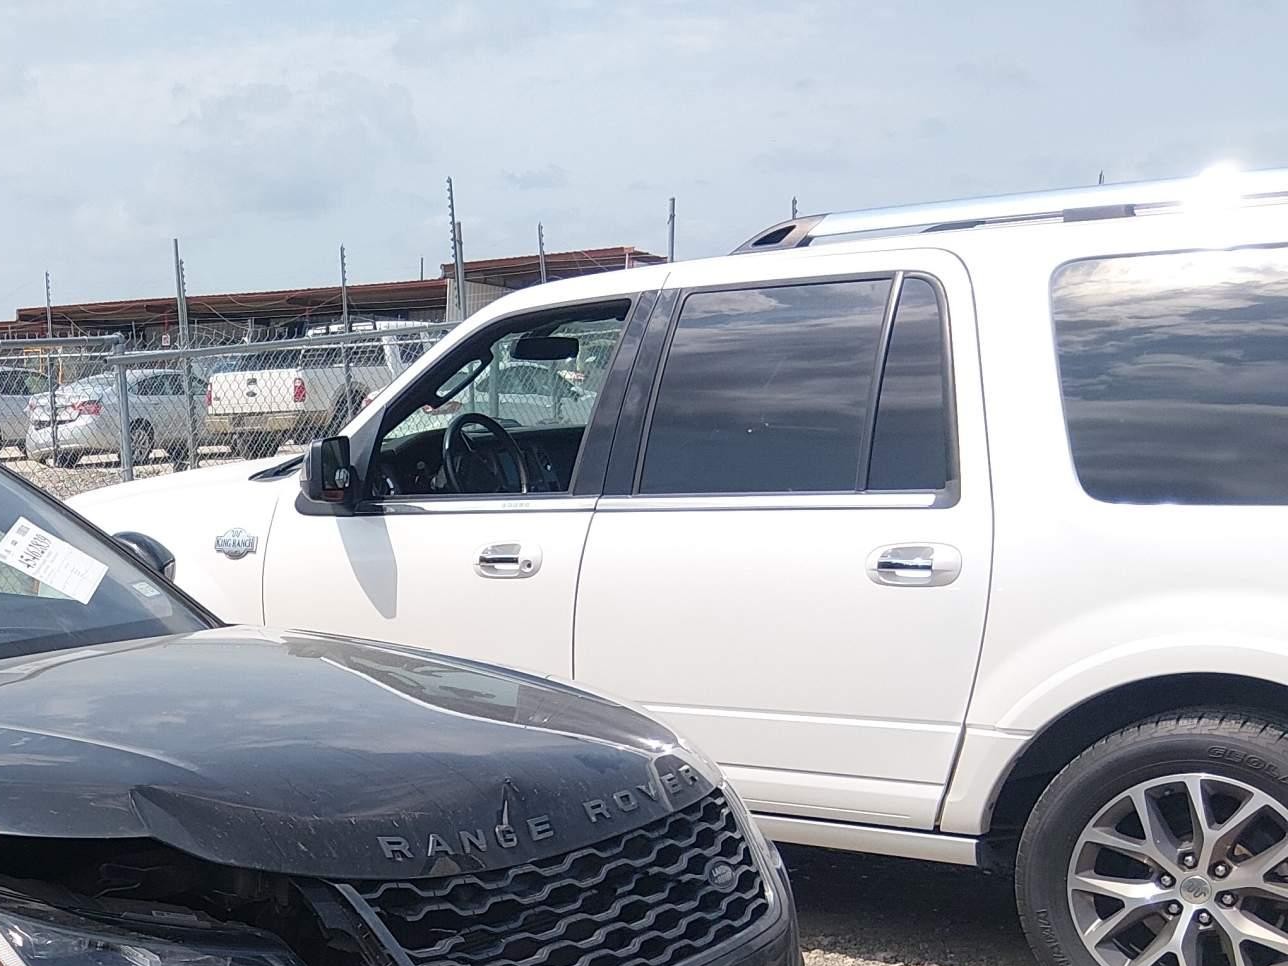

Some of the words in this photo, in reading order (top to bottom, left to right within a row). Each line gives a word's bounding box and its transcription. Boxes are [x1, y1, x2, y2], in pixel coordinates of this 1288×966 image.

[215, 537, 232, 549] KING
[232, 537, 255, 549] RANCH
[376, 814, 555, 861] RANGE
[581, 763, 699, 824] ROVER
